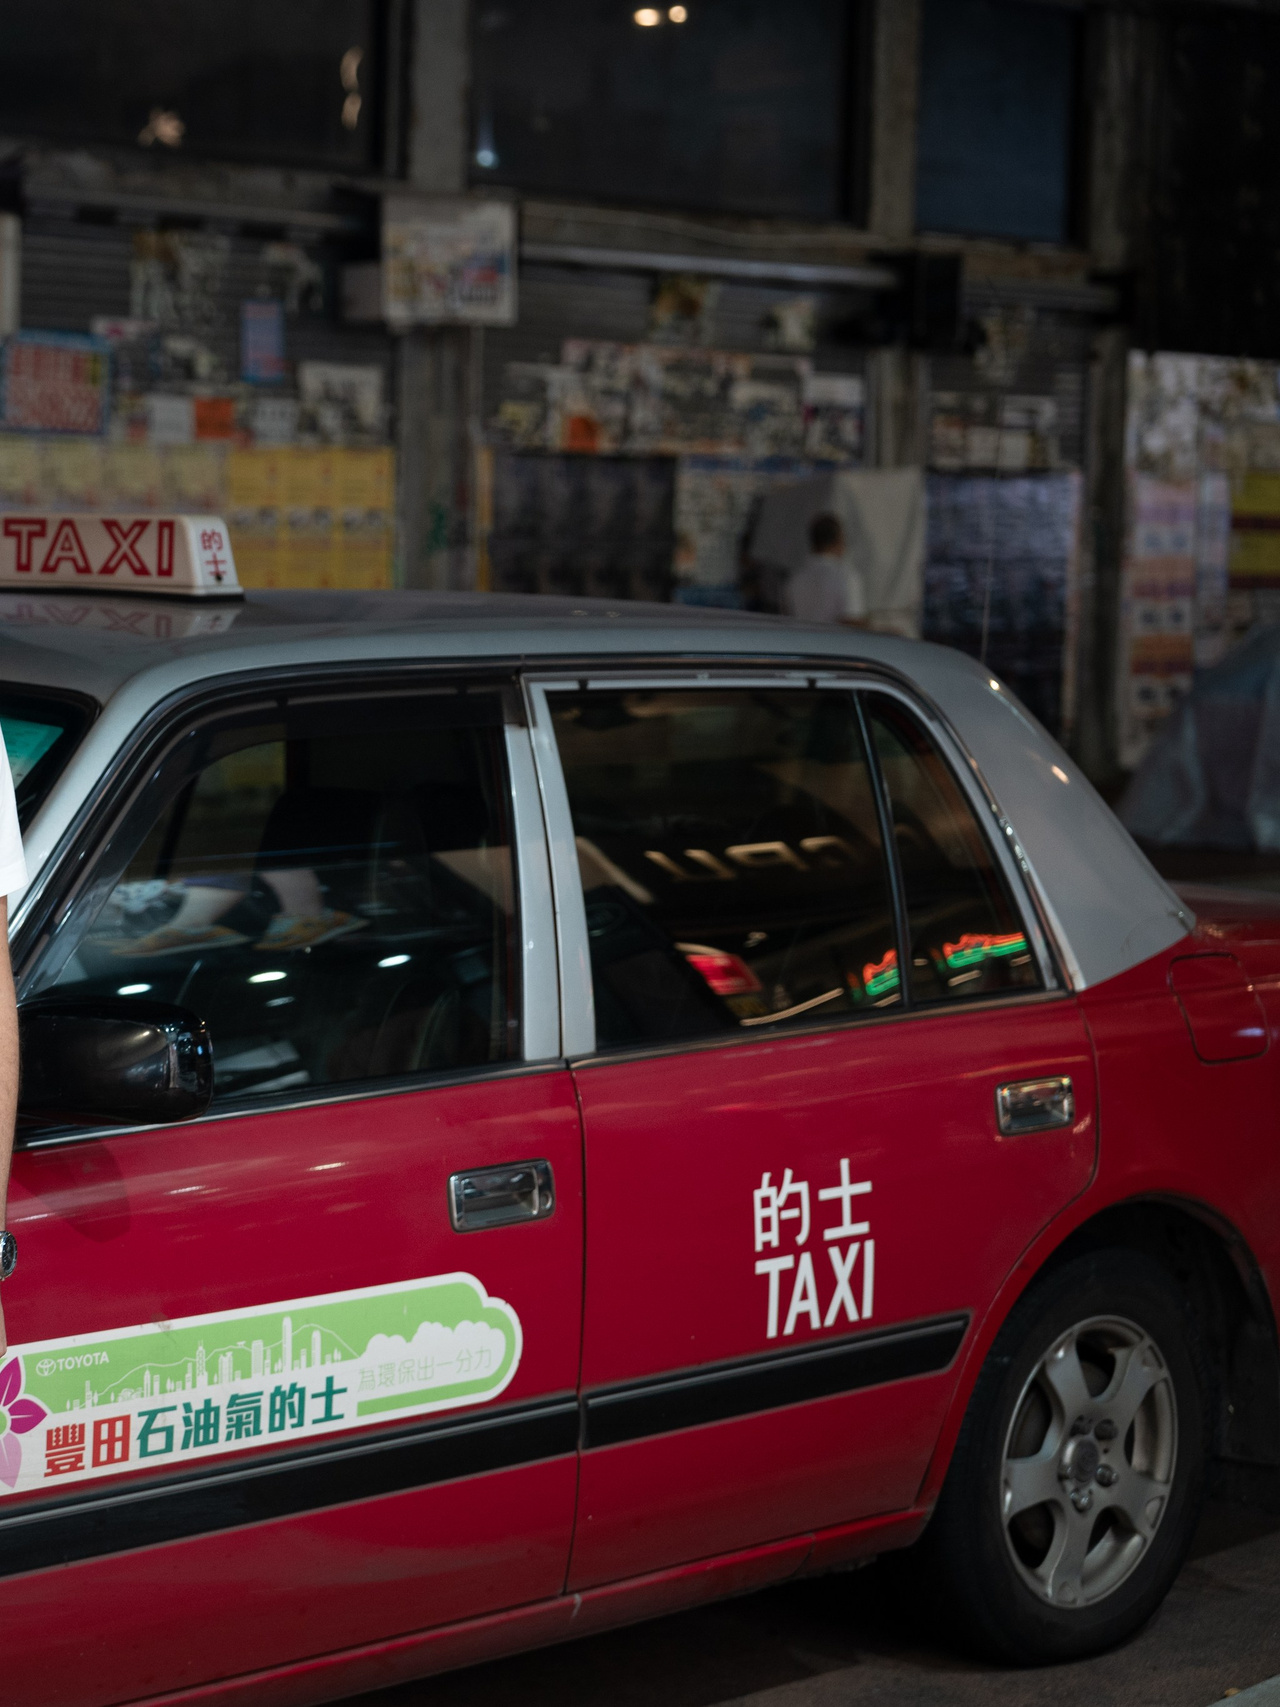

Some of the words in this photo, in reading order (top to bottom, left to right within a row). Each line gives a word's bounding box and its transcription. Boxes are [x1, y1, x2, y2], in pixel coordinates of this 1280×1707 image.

[3, 517, 175, 577] TAXI
[201, 528, 227, 577] 的士
[753, 1158, 873, 1252] 的士
[755, 1239, 875, 1339] TAXI
[56, 1351, 110, 1372] TOYOTA
[43, 1375, 348, 1478] 豐田石油氣的士
